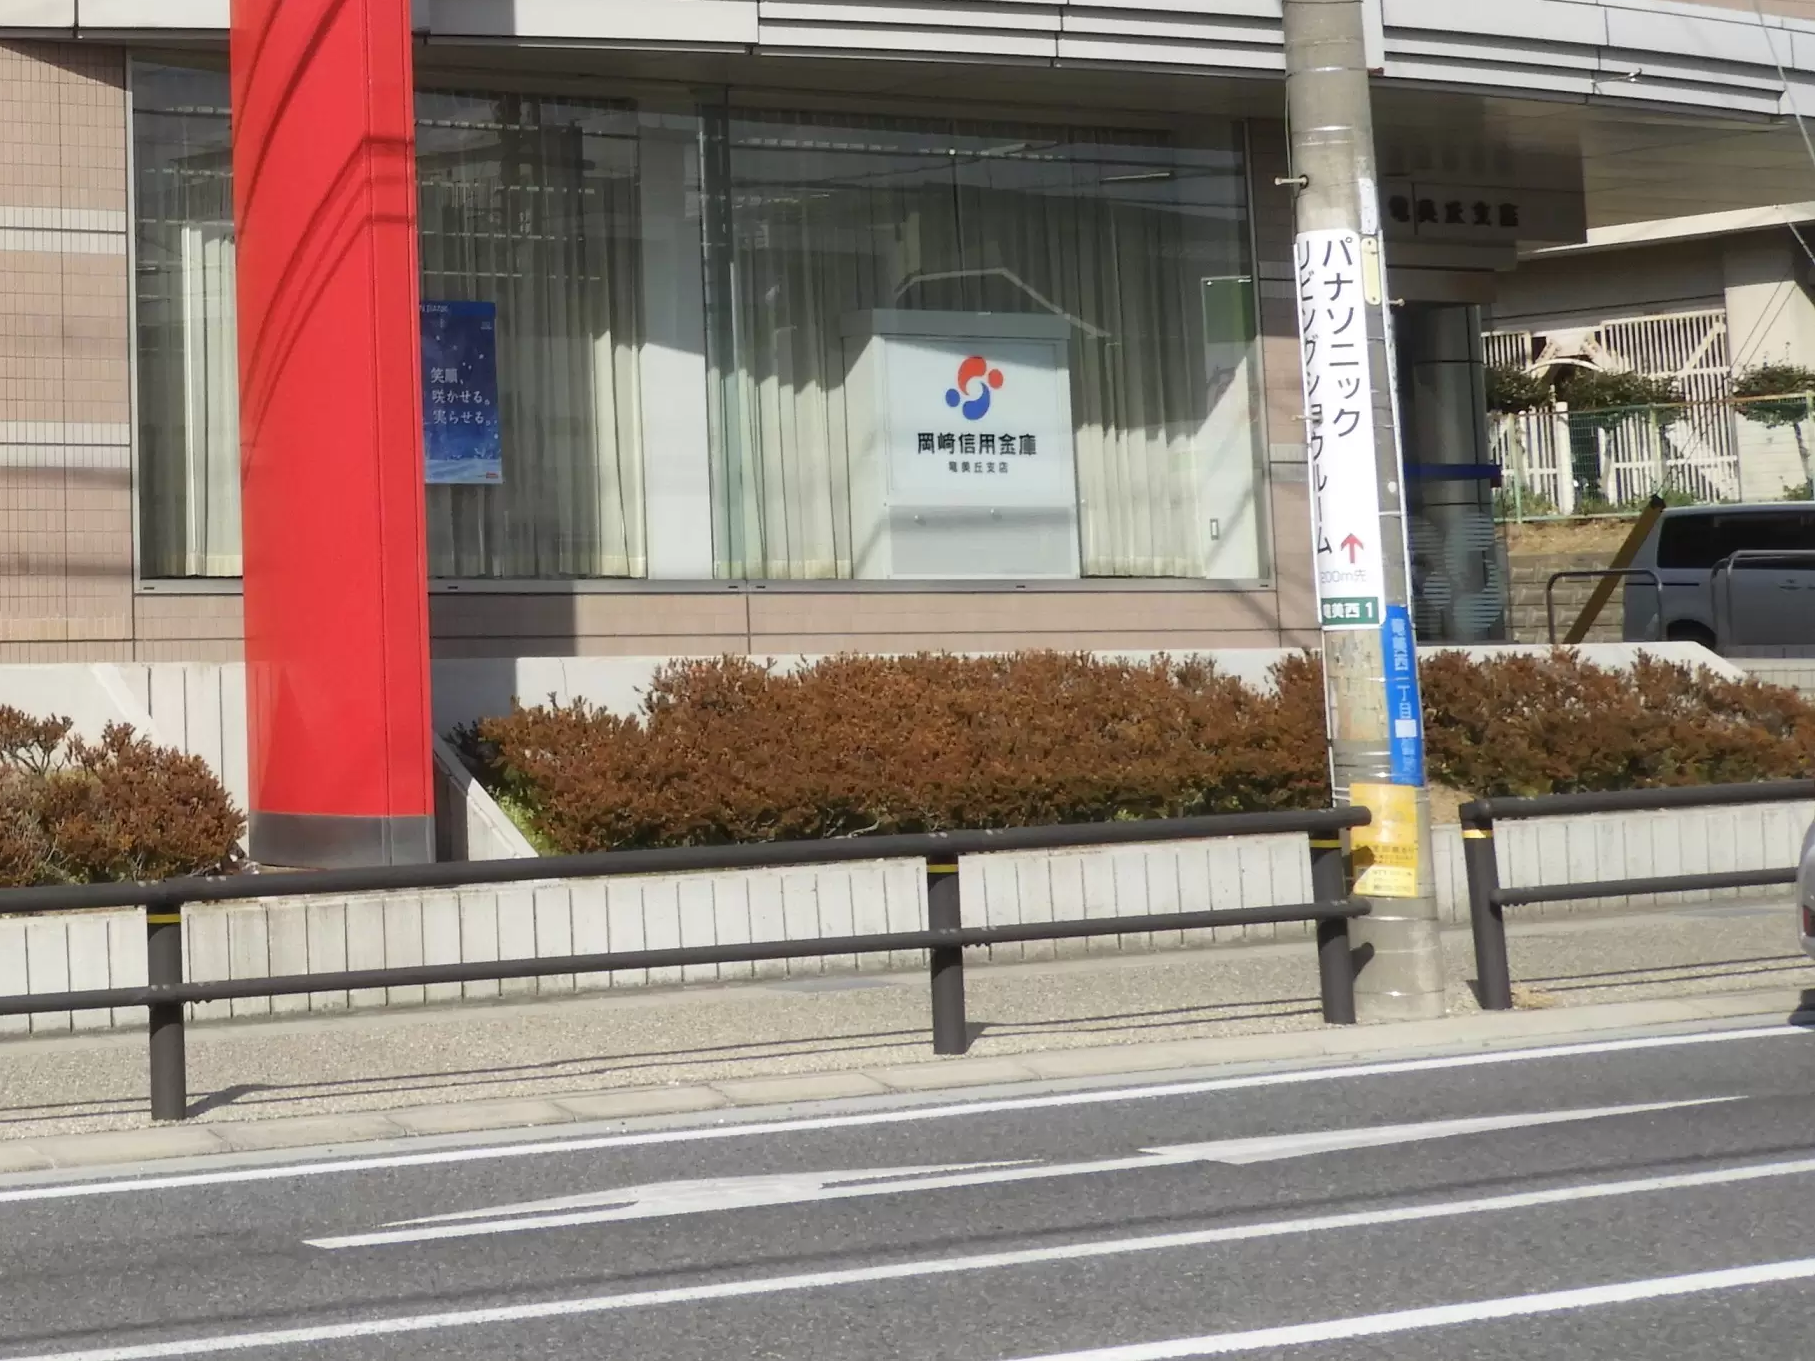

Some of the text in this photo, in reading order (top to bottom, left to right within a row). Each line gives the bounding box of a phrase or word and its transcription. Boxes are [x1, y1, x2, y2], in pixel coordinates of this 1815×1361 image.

[1323, 237, 1360, 437] パナソニック
